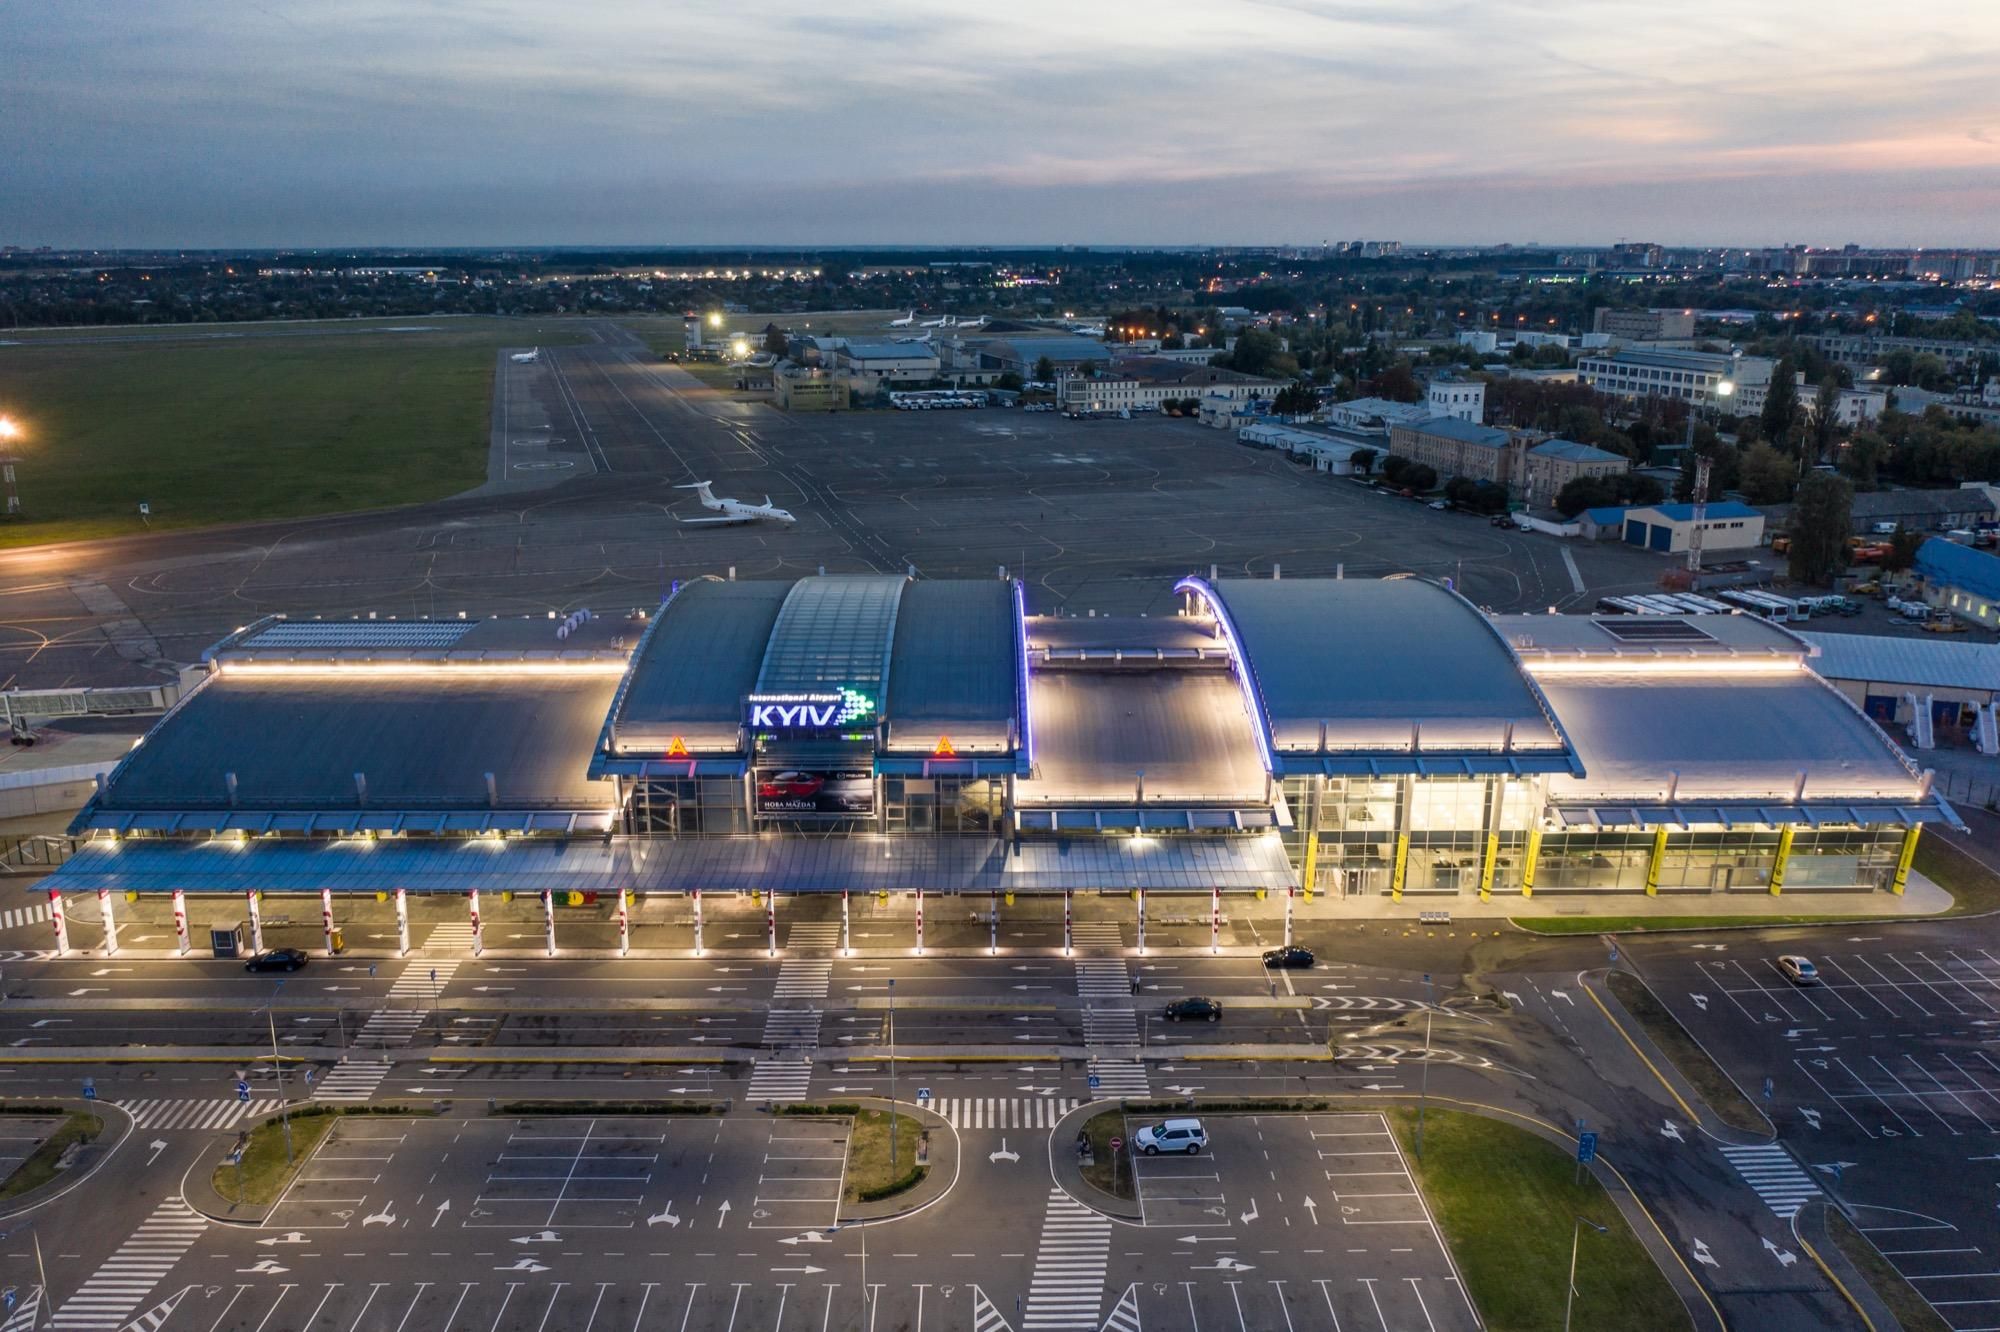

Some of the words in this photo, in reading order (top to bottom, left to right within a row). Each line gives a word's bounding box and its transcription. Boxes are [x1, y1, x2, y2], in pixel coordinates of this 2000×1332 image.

[749, 694, 807, 702] International
[809, 694, 841, 703] Airport
[752, 705, 836, 726] KYIV
[668, 736, 688, 755] A
[935, 736, 954, 755] A
